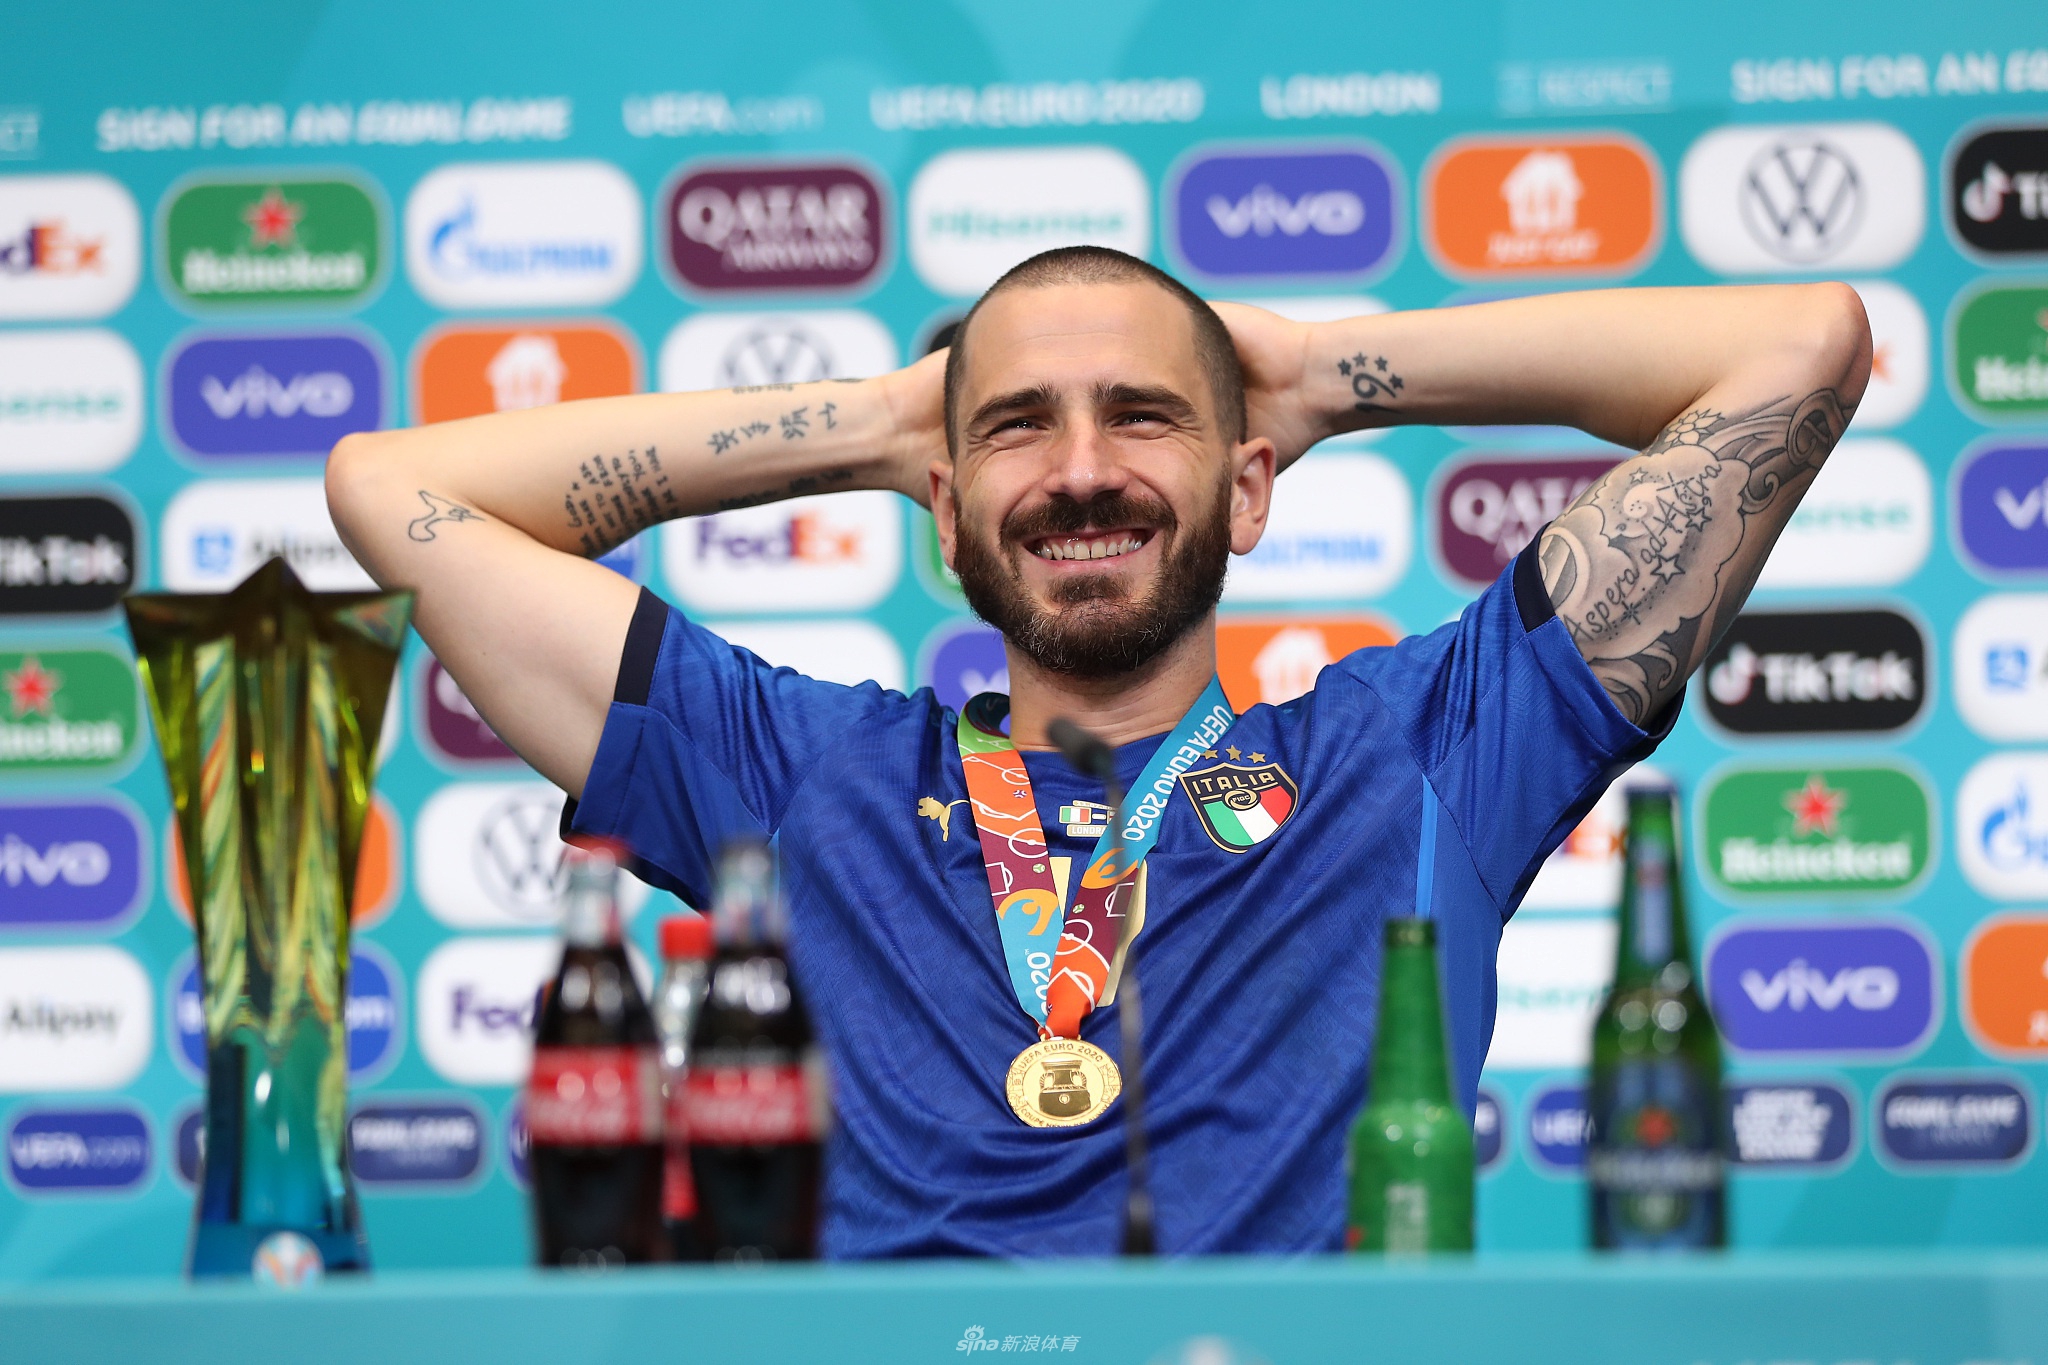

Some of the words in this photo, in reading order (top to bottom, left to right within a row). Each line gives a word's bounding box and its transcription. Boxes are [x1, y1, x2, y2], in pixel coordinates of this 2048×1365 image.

[1731, 59, 1834, 102] SIGN
[1839, 56, 1929, 98] FOR
[1935, 53, 1998, 95] AN
[679, 185, 869, 251] QATAR
[1205, 184, 1365, 238] vivo
[0, 219, 106, 275] dEx
[200, 364, 355, 418] vivo
[695, 514, 864, 567] FedEx
[1759, 649, 1918, 704] TikTok
[1193, 704, 1233, 749] UEFA
[1154, 747, 1201, 795] EURO
[1191, 771, 1276, 795] ITALIA
[1121, 792, 1168, 842] 2020
[0, 833, 111, 888] ivo
[1740, 957, 1899, 1012] vivo
[1020, 1048, 1042, 1071] UEFA
[1044, 1043, 1074, 1054] EURO
[1078, 1045, 1103, 1063] 2020
